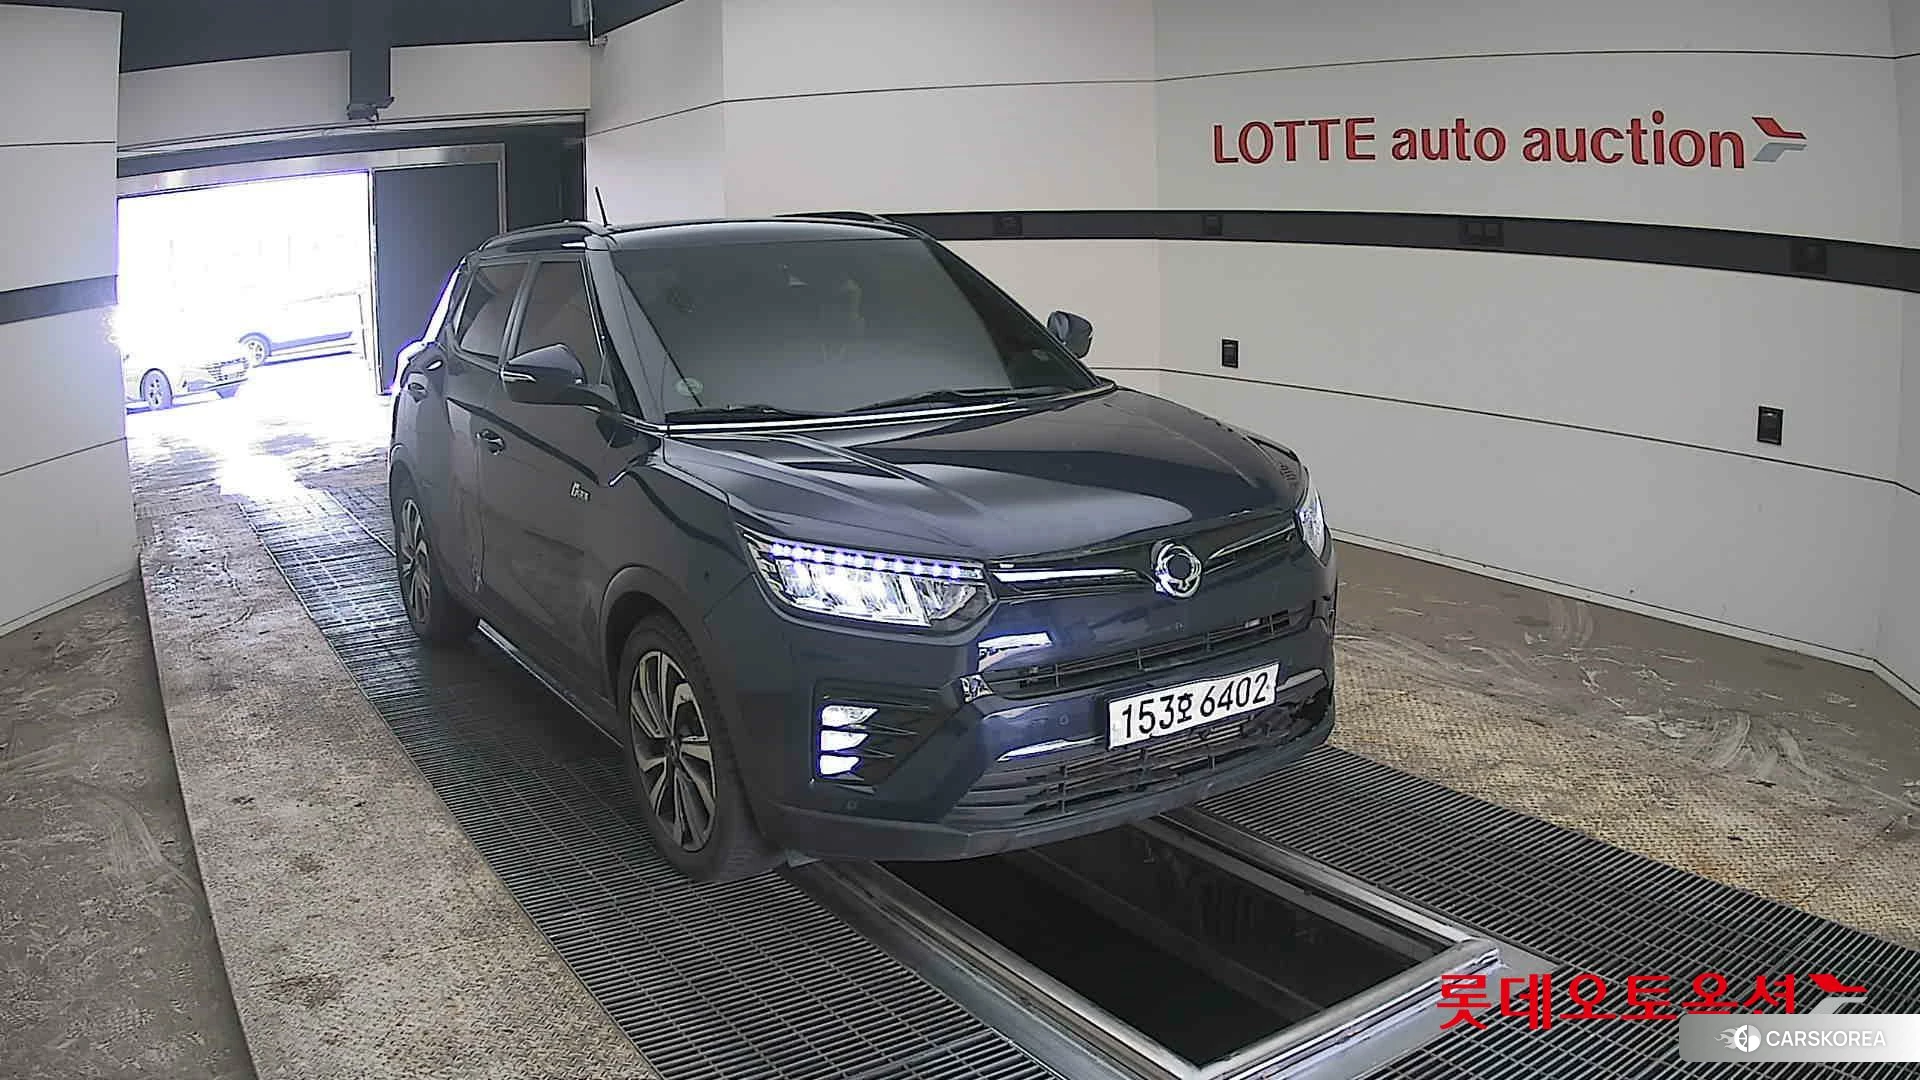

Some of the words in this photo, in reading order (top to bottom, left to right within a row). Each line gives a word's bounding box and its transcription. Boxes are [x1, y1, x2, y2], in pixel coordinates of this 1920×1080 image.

[1213, 116, 1376, 164] LOTTE
[1391, 118, 1506, 162] auto
[1522, 109, 1745, 169] auction
